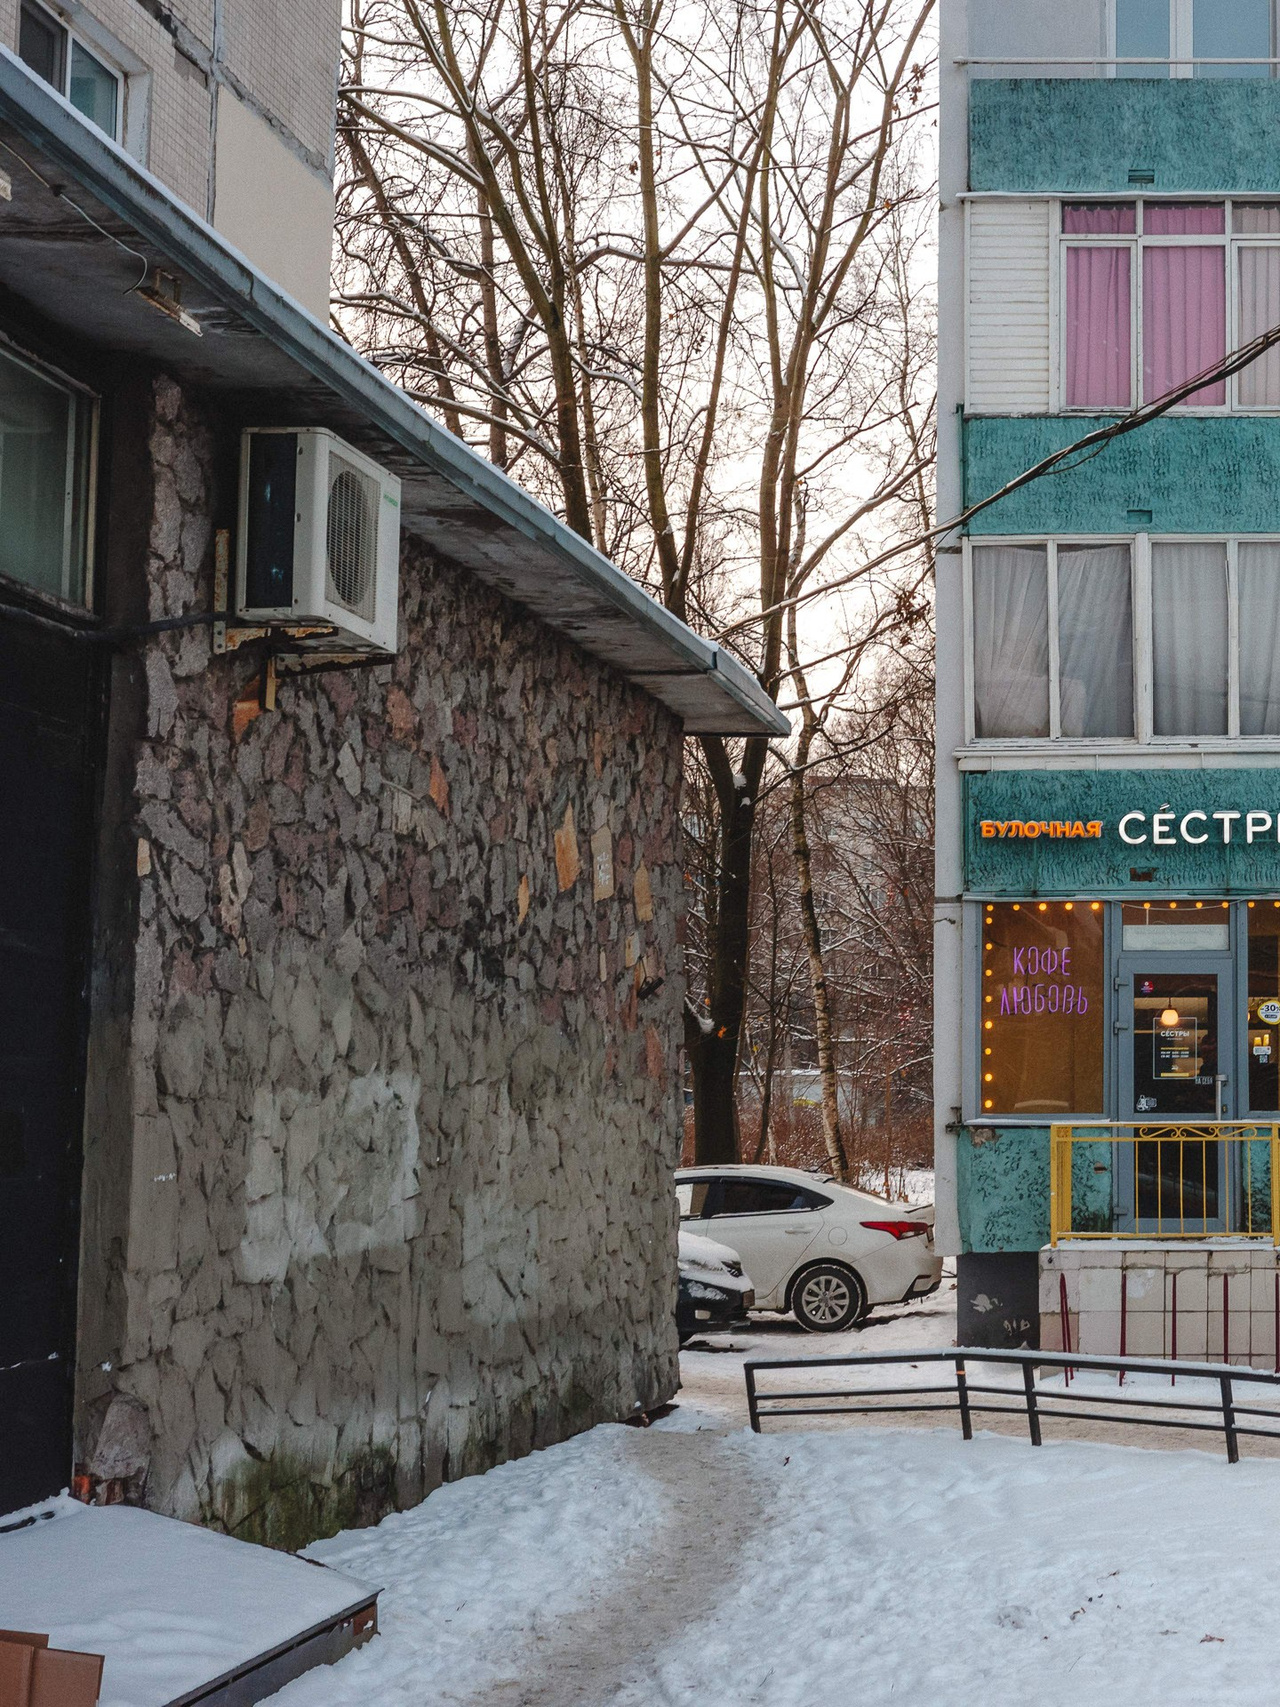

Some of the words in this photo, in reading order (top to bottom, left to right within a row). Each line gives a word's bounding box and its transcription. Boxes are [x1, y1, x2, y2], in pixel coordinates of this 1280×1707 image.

[980, 820, 1103, 838] БУЛОЧНАЯ
[1013, 946, 1071, 976] КОФЕ
[1000, 984, 1088, 1016] ЛЮБОВЬ
